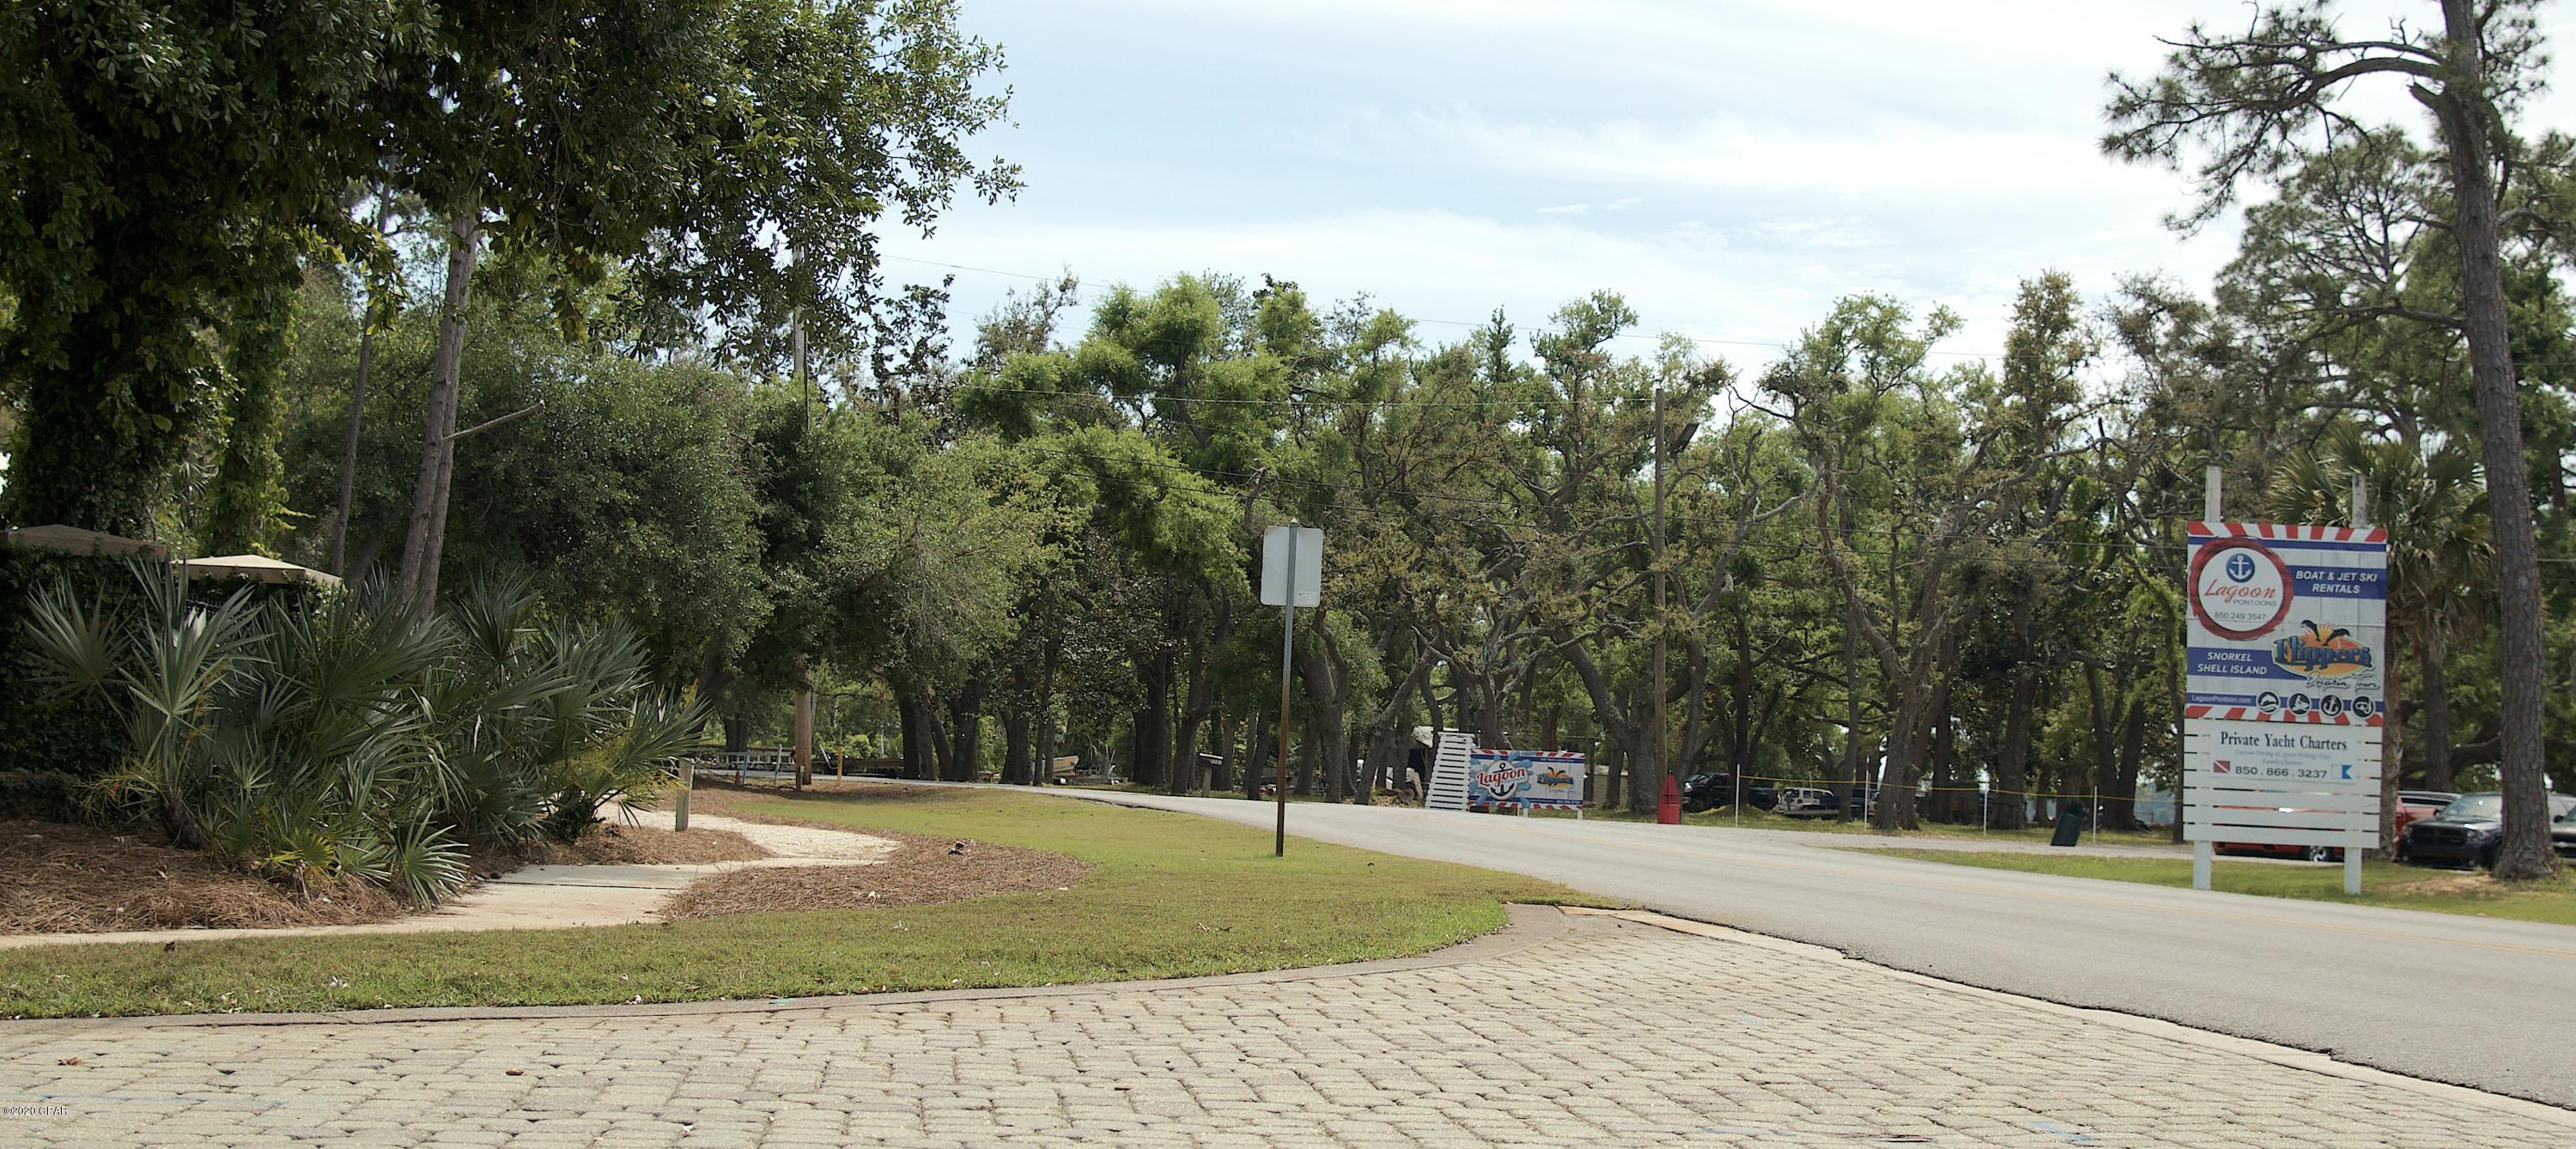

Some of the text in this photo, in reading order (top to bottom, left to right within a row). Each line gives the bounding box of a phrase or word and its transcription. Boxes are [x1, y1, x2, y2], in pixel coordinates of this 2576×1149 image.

[2295, 570, 2378, 583] BOAT & JET SKI
[2204, 579, 2275, 604] Lagoon
[2312, 583, 2360, 594] RENTALS
[2207, 652, 2252, 662] SNORKEL
[2272, 635, 2372, 672] Flippers
[2197, 663, 2268, 675] SHELL ISLAND
[2221, 731, 2348, 751] Private Yacht Charters
[1477, 768, 1525, 787] Lagoon
[2234, 765, 2258, 775] 850
[2297, 769, 2328, 779] 3237
